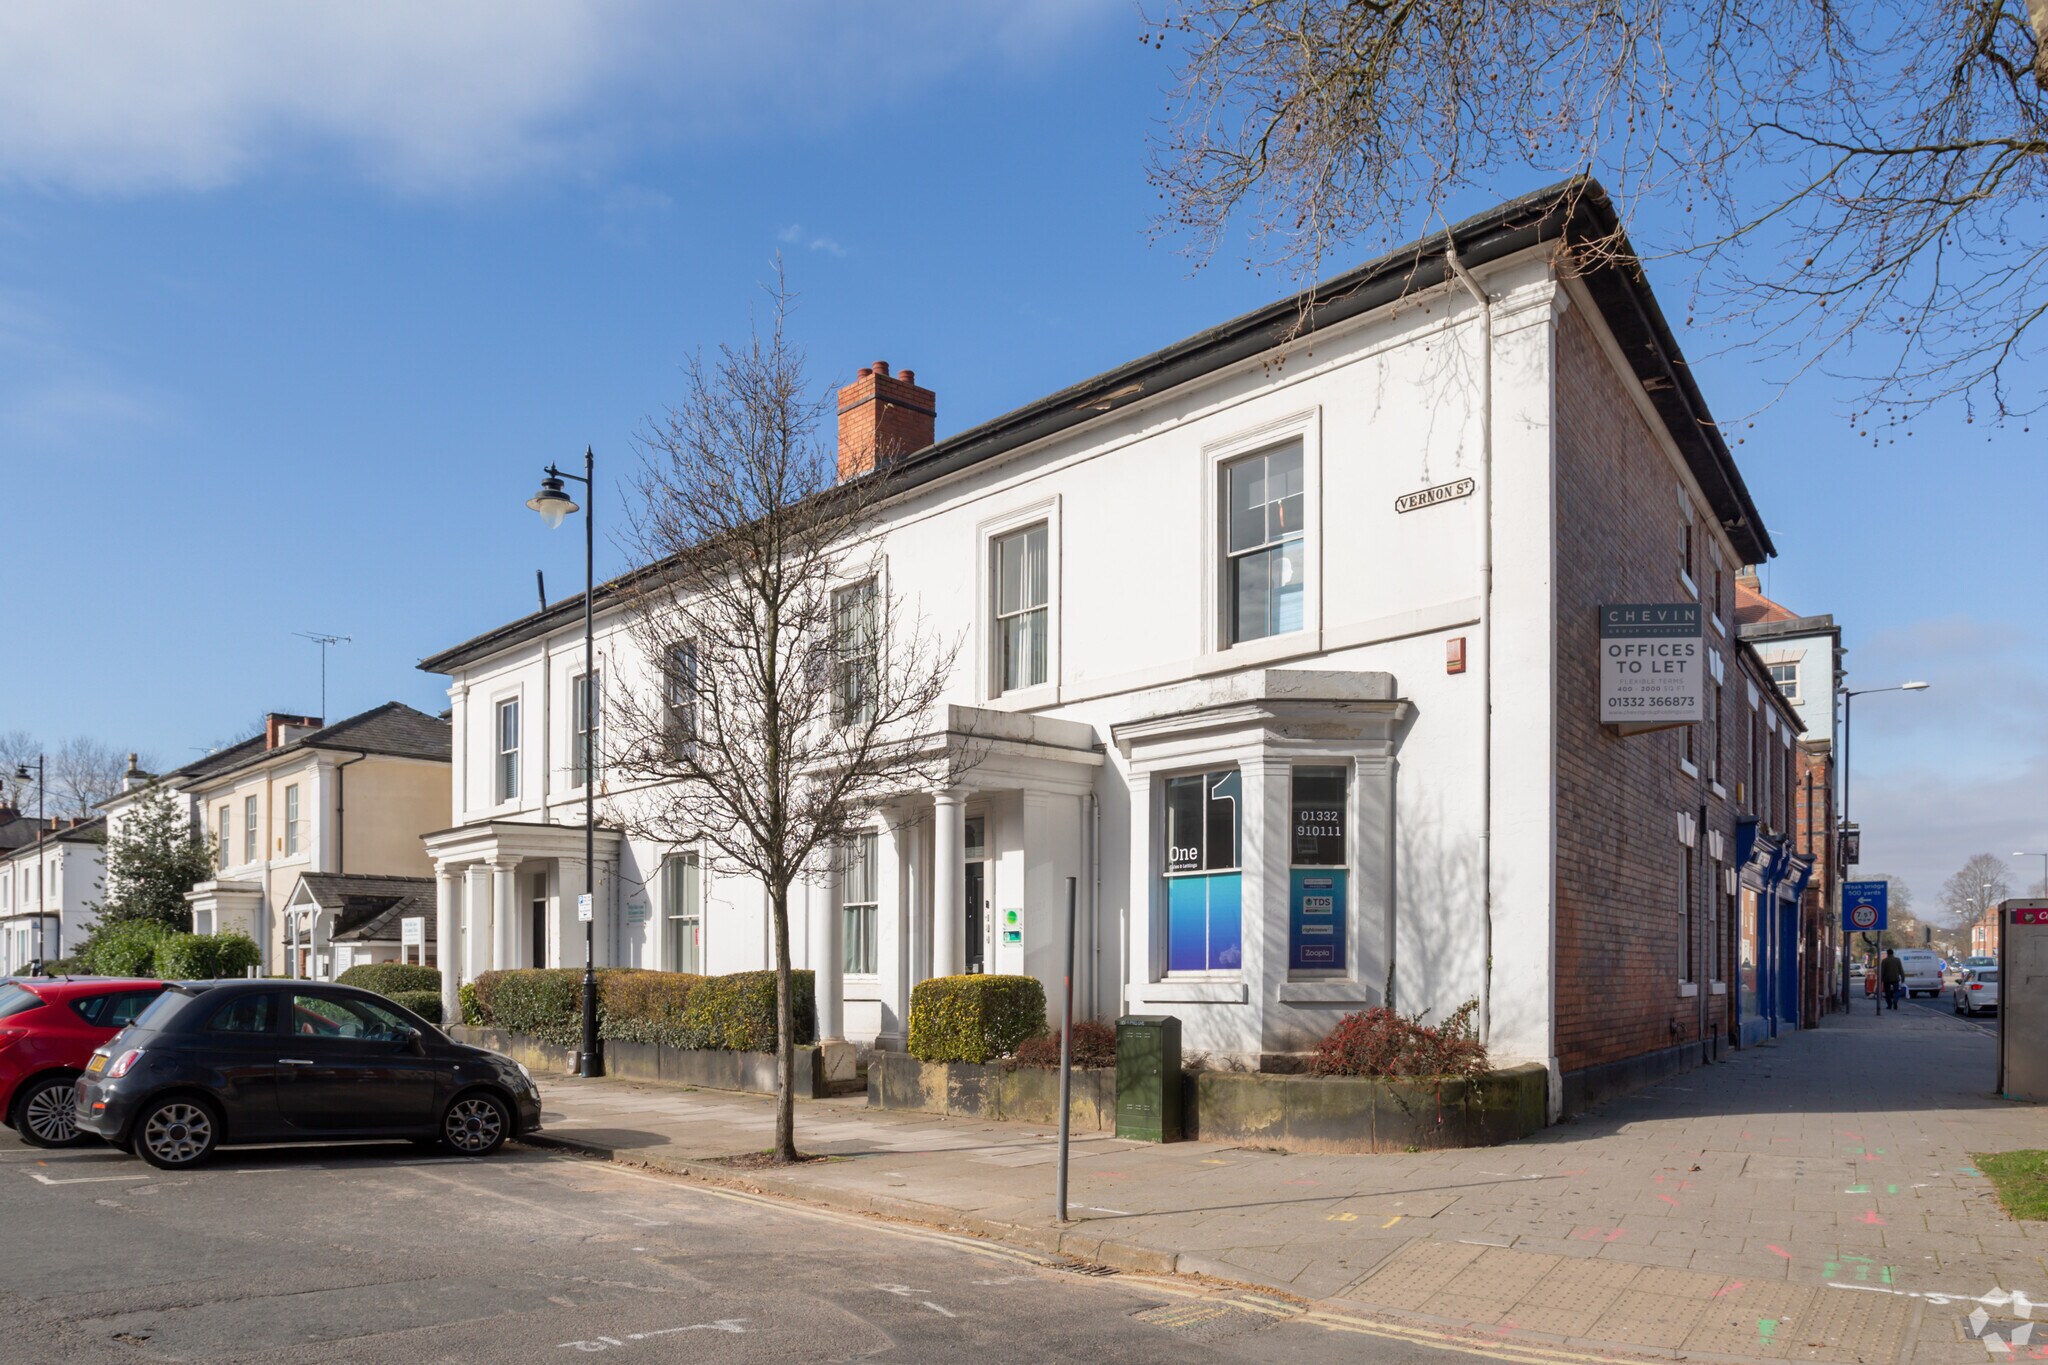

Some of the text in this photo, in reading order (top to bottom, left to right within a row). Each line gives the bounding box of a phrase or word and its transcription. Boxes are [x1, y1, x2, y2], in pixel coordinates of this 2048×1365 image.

[1400, 486, 1452, 509] VERNON
[1609, 610, 1695, 622] CHEVIN
[1609, 644, 1695, 657] OFFICES
[1616, 660, 1687, 673] TO LET
[1609, 696, 1695, 707] 01332 366873
[1301, 811, 1338, 821] 01332
[1297, 826, 1341, 837] 910111
[1169, 846, 1198, 862] One
[1313, 898, 1331, 906] TDS
[1305, 949, 1330, 958] Zoopla
